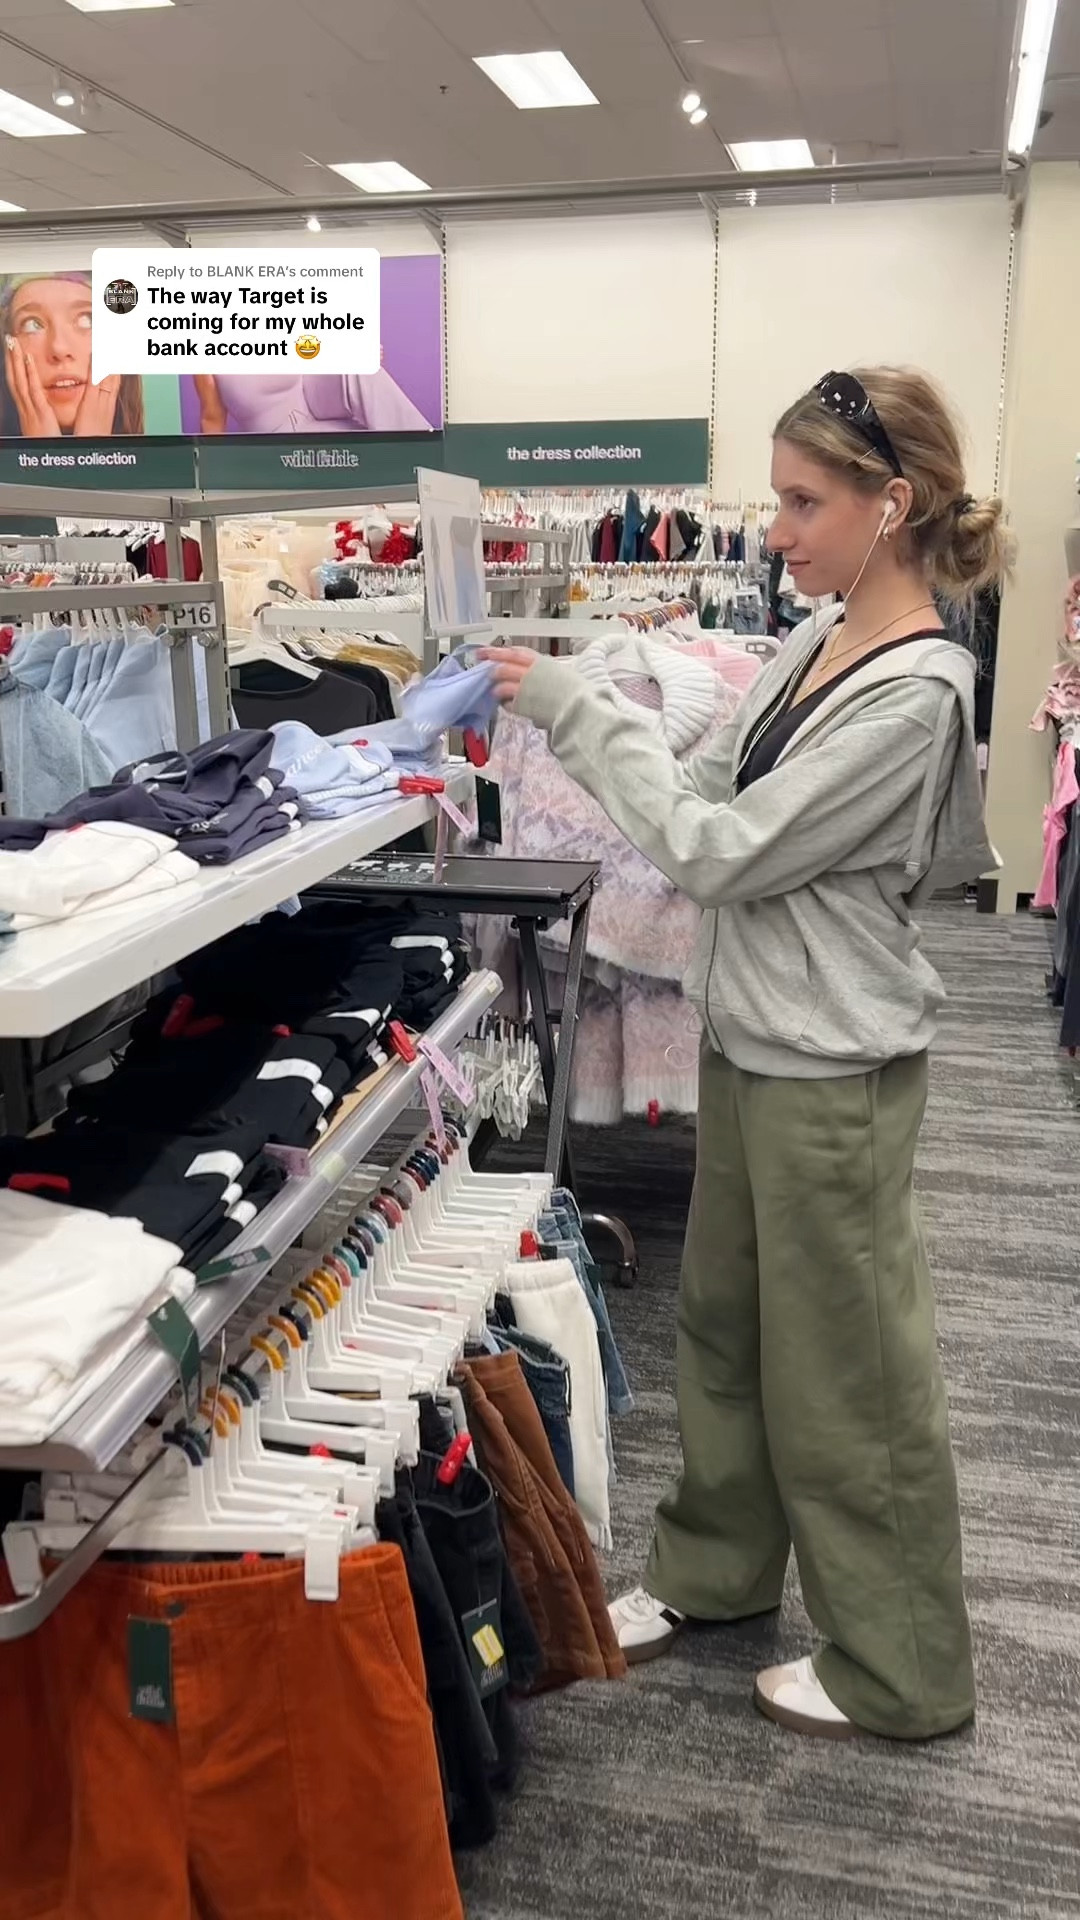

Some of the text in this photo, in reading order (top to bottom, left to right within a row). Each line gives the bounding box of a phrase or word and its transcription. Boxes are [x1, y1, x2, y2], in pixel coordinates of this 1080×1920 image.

[18, 451, 137, 467] the dress collection
[280, 449, 316, 468] wild
[507, 444, 642, 460] the dress collection
[173, 606, 211, 625] P16
